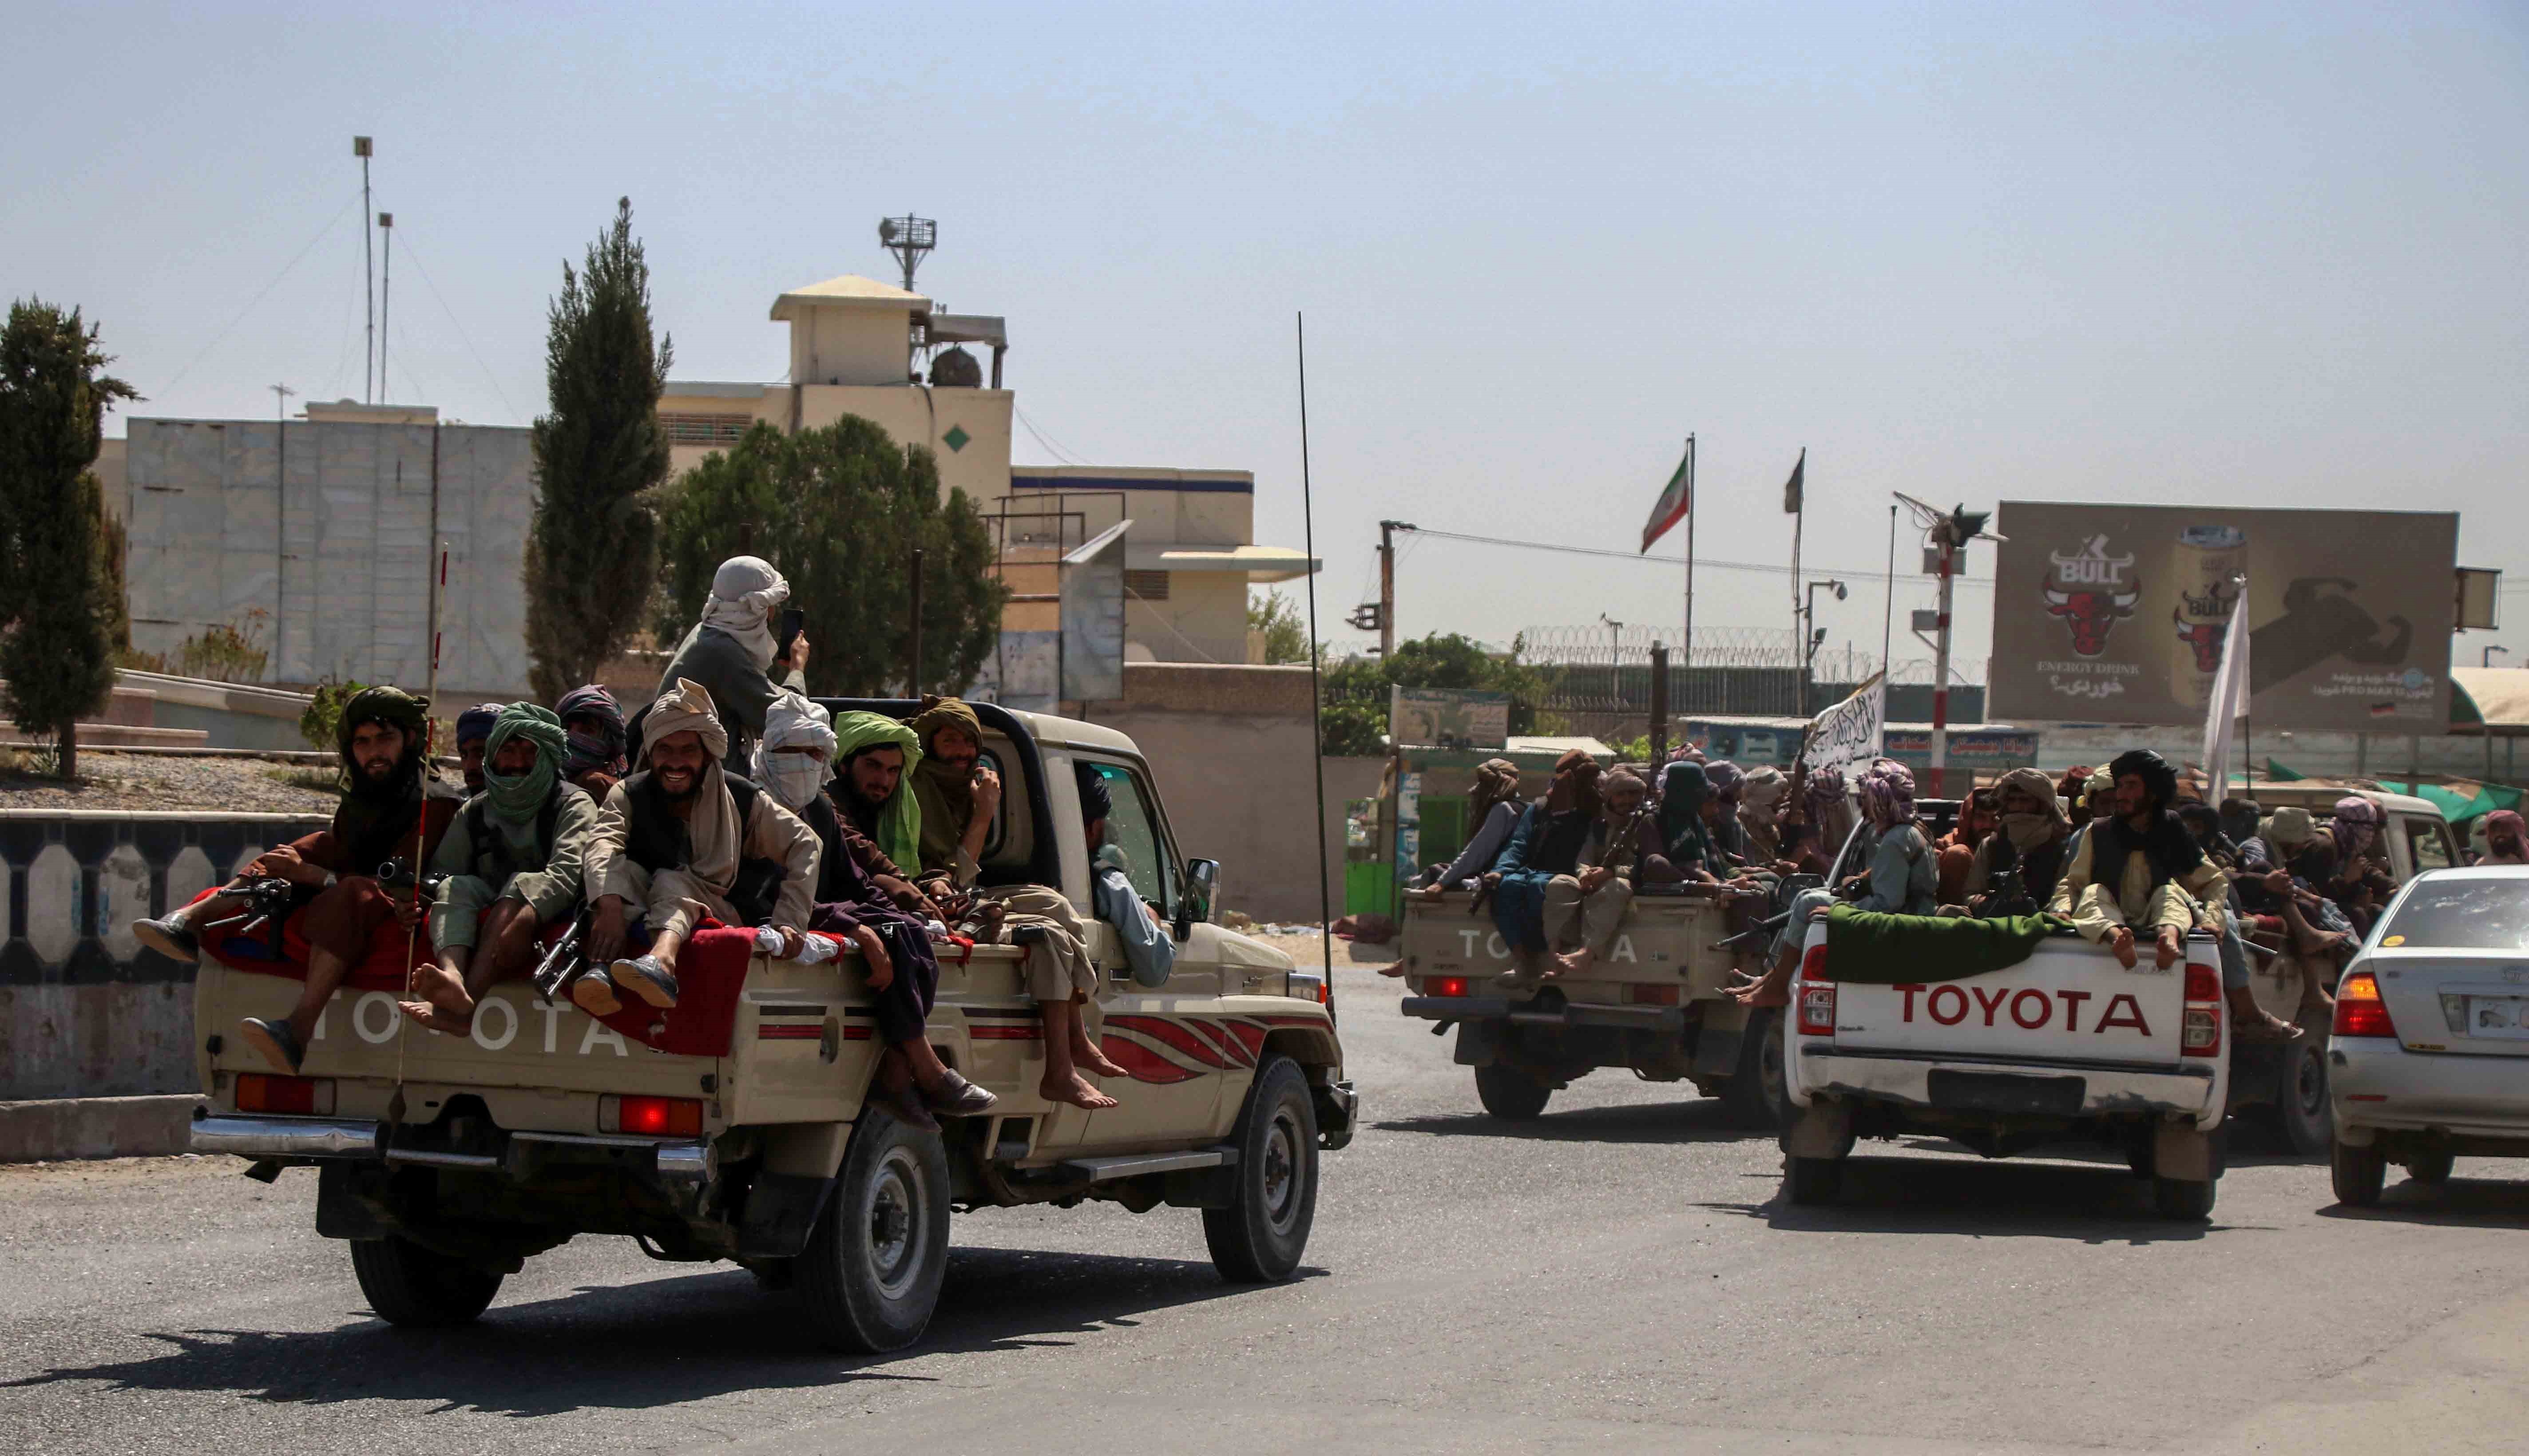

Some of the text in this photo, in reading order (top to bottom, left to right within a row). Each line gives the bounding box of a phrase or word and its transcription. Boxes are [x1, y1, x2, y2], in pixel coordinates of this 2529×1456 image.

[2056, 557, 2131, 583] BULL
[2037, 661, 2141, 675] ENERGY DRINK
[1459, 930, 1637, 963] TOA
[313, 989, 629, 1056] OOTA
[1893, 984, 2152, 1037] TOYOTA
